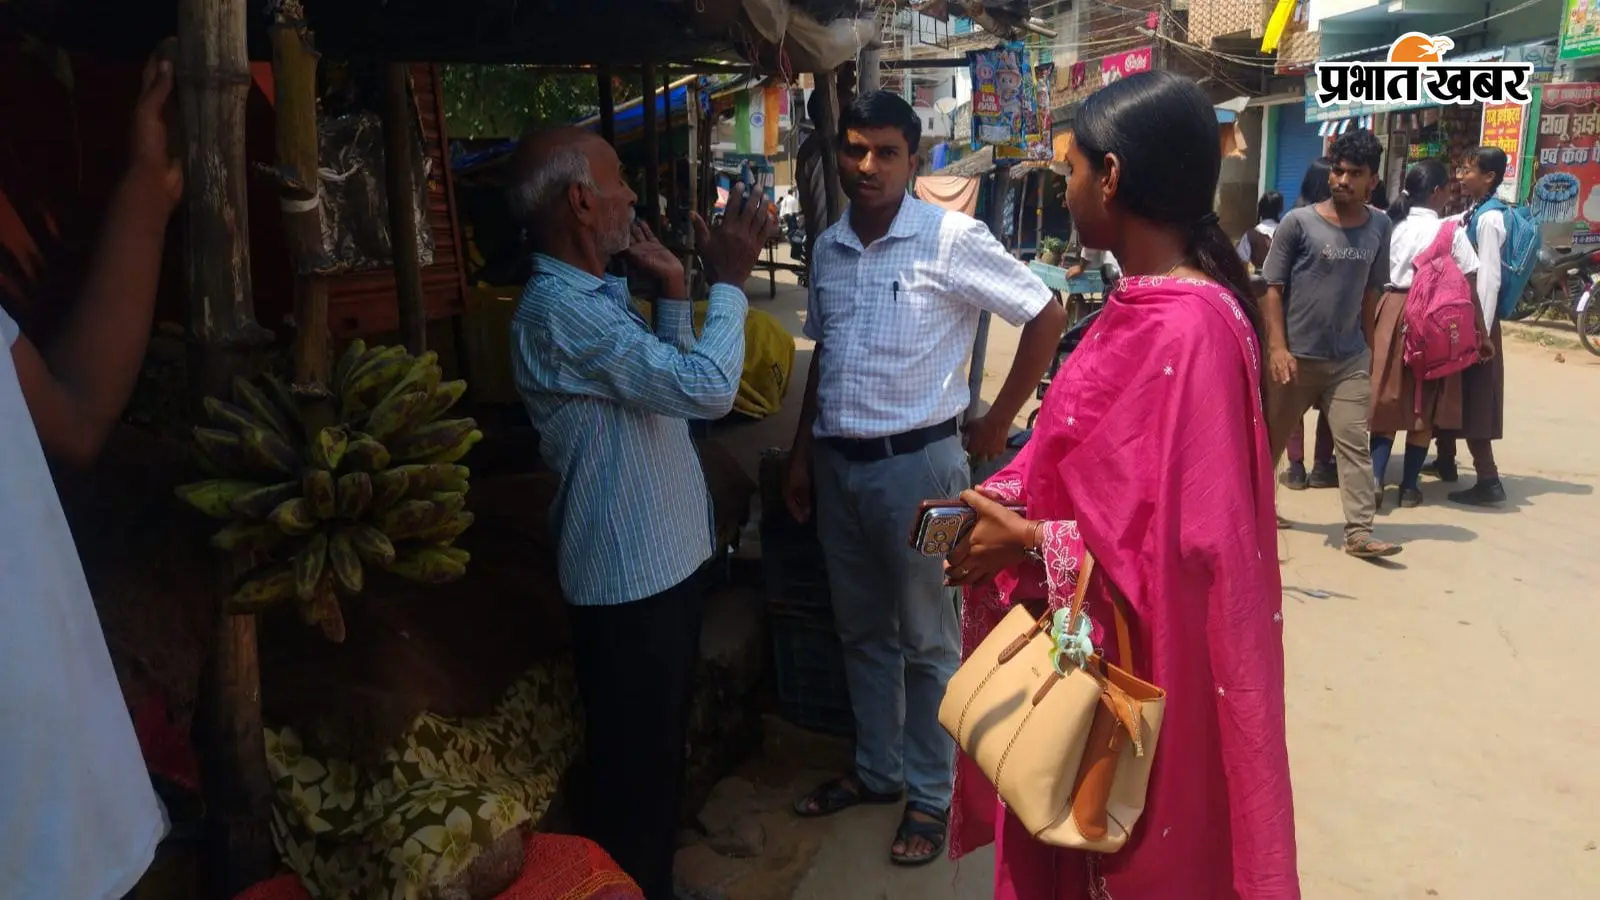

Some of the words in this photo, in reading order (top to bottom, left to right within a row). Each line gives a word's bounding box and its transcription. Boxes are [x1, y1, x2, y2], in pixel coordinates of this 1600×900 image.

[1541, 114, 1570, 141] राजू
[1540, 143, 1560, 164] एवं
[1561, 144, 1590, 165] केक
